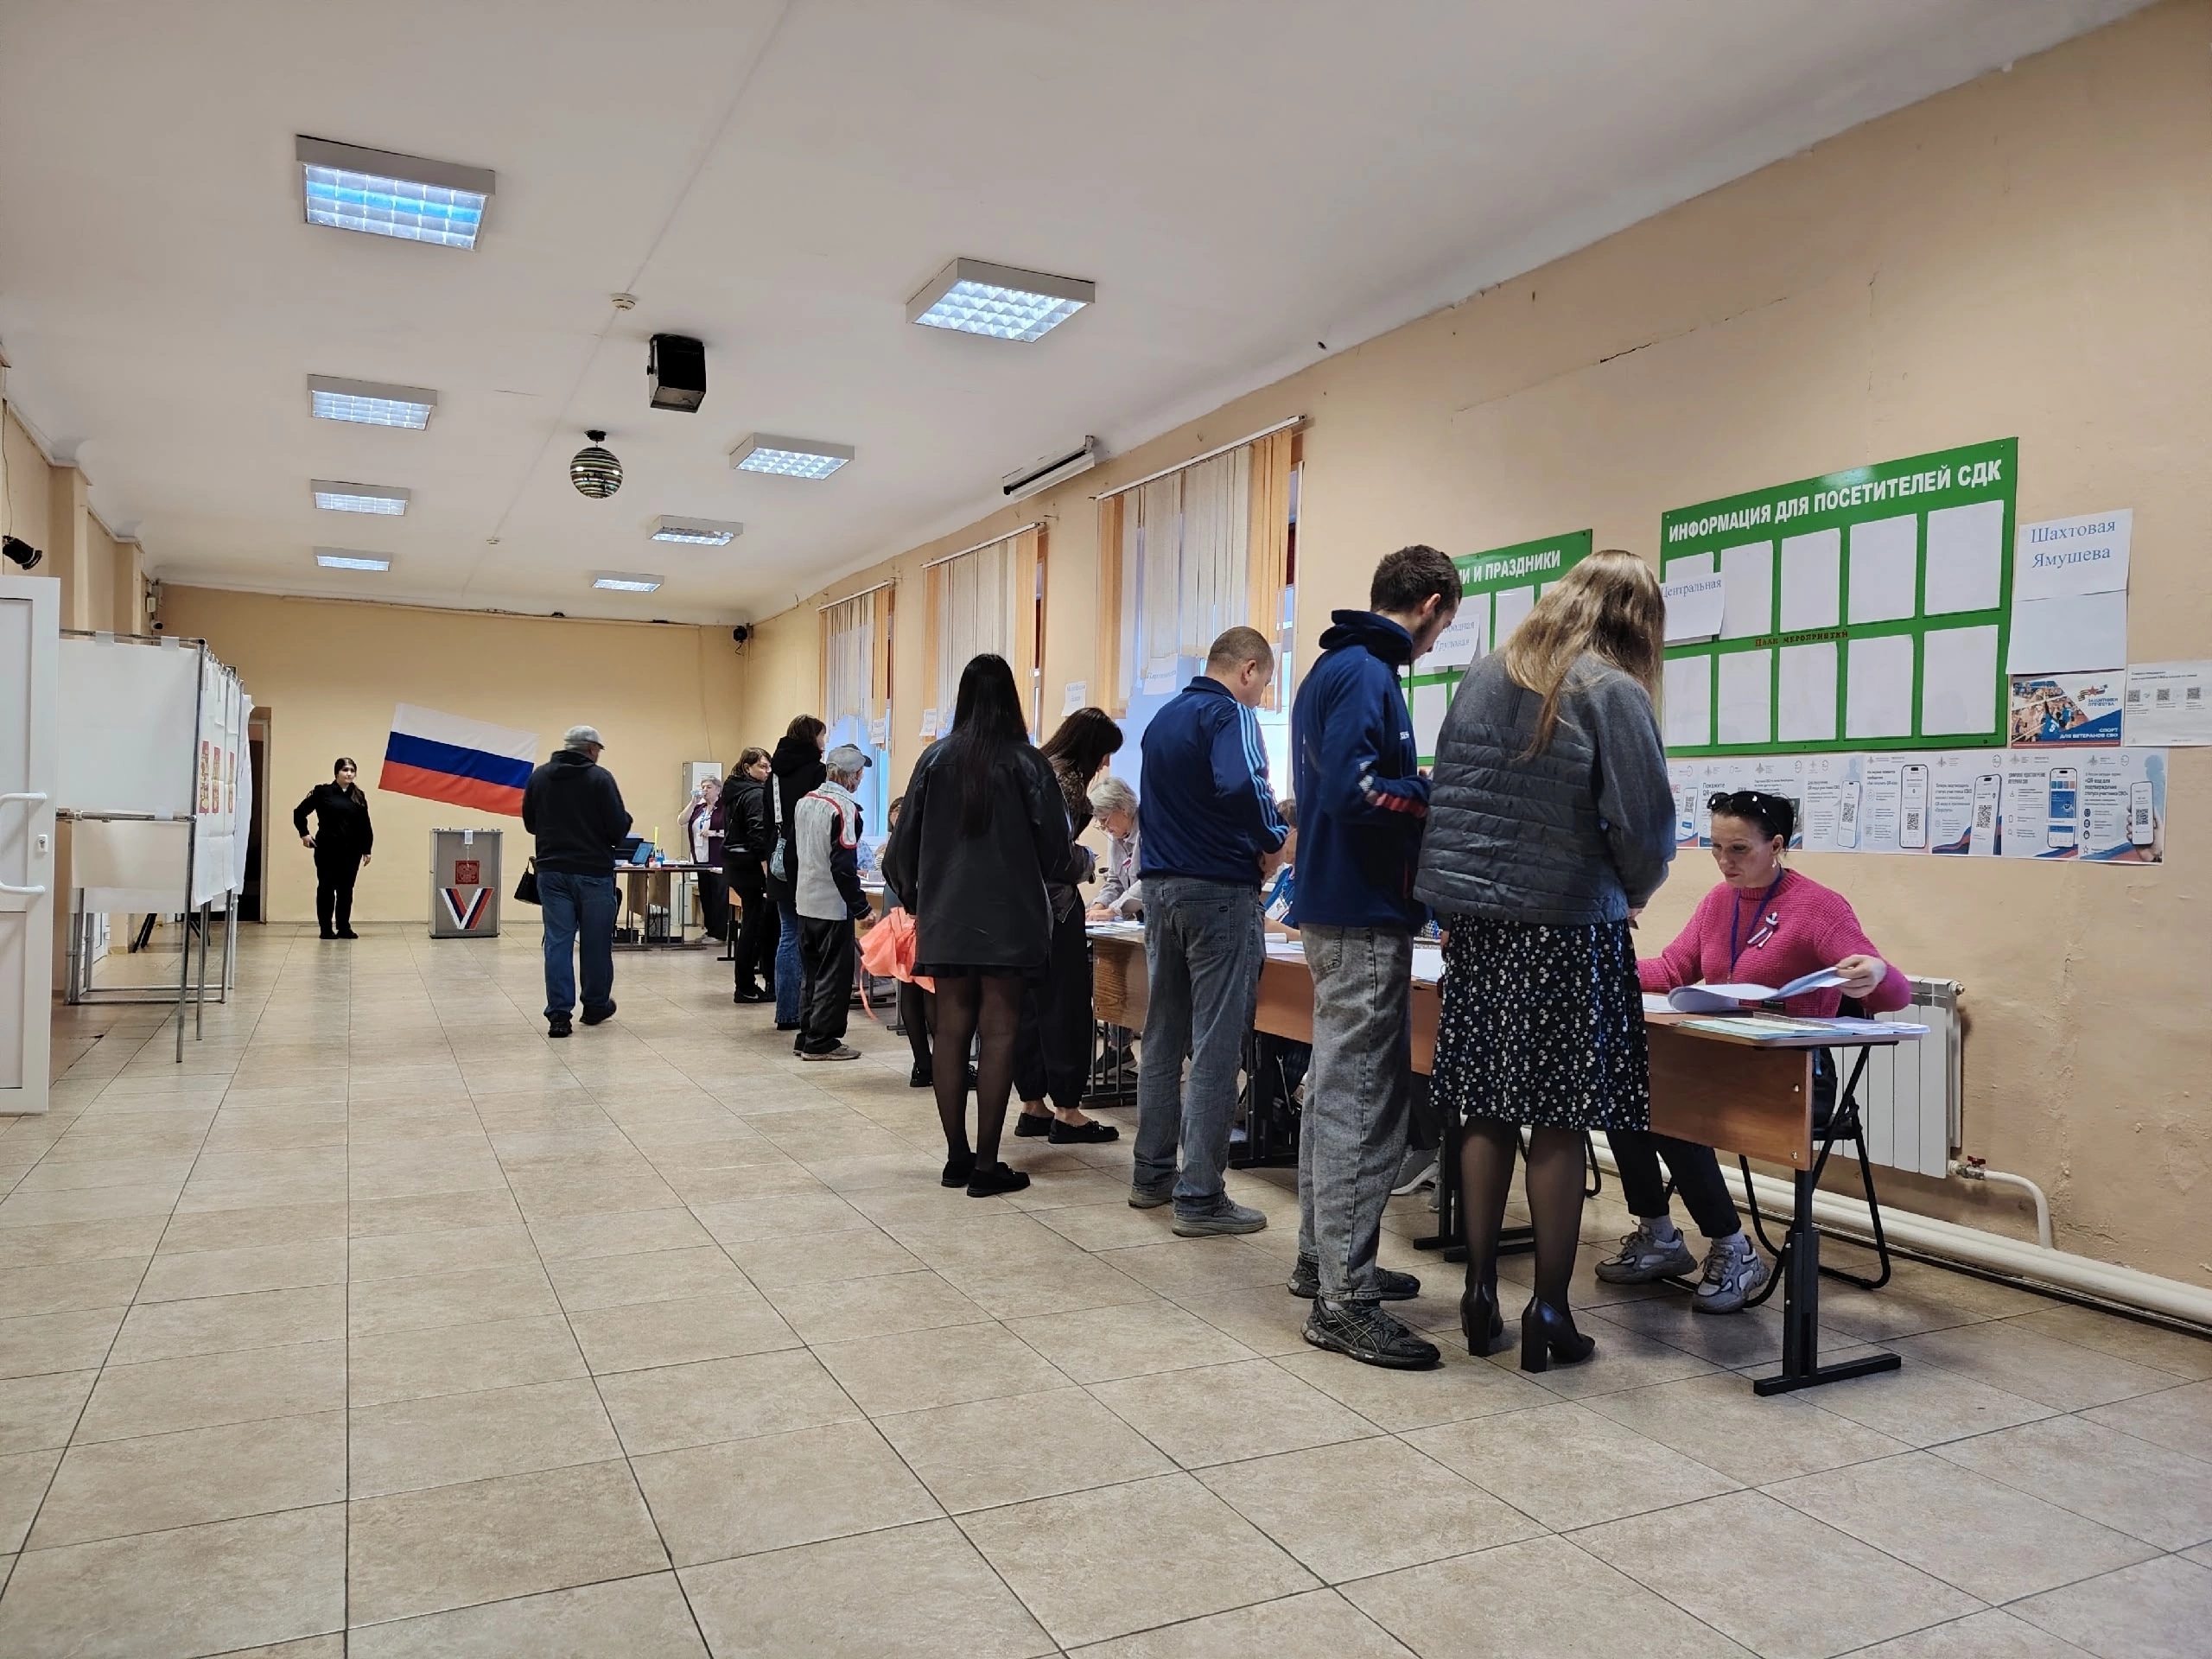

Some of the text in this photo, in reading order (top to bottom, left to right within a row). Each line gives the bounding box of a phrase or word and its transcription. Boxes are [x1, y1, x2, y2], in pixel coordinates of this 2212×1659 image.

[1669, 459, 2002, 543] ИНФОРМАЦИЯ ДЛЯ ПОСЕТИТЕЛЕЙ СДК
[2031, 521, 2115, 543] Шахтовая
[1473, 566, 1483, 582] И
[1484, 550, 1560, 578] ПРАЗДНИКИ
[2031, 548, 2110, 569] Ямушева
[1661, 580, 1722, 598] Центральная
